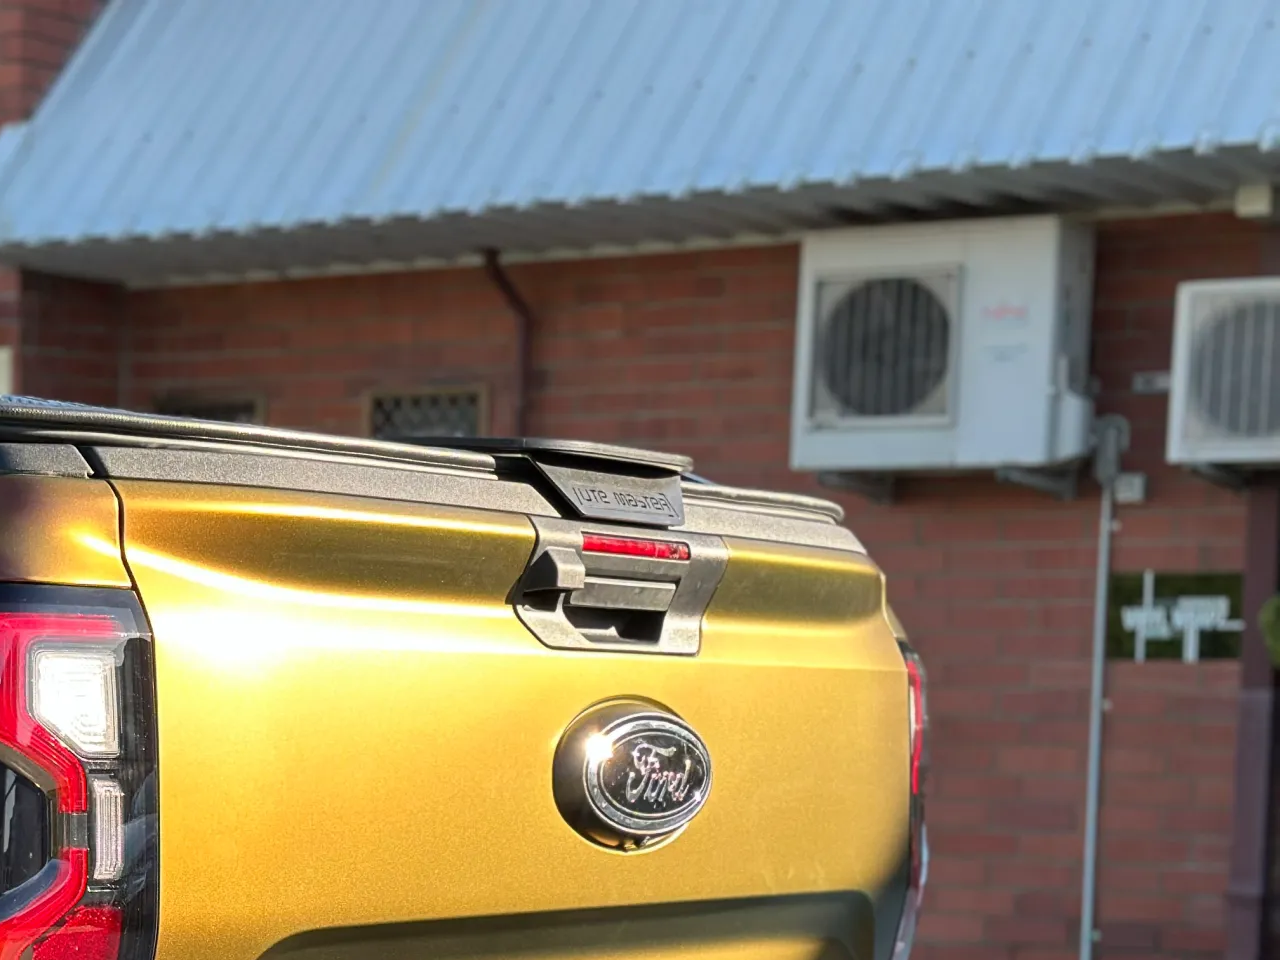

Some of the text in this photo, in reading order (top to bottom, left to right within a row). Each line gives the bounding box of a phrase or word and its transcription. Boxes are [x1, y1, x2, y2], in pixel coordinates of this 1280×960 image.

[578, 487, 671, 512] UTE MASTER
[625, 742, 692, 803] Ford
